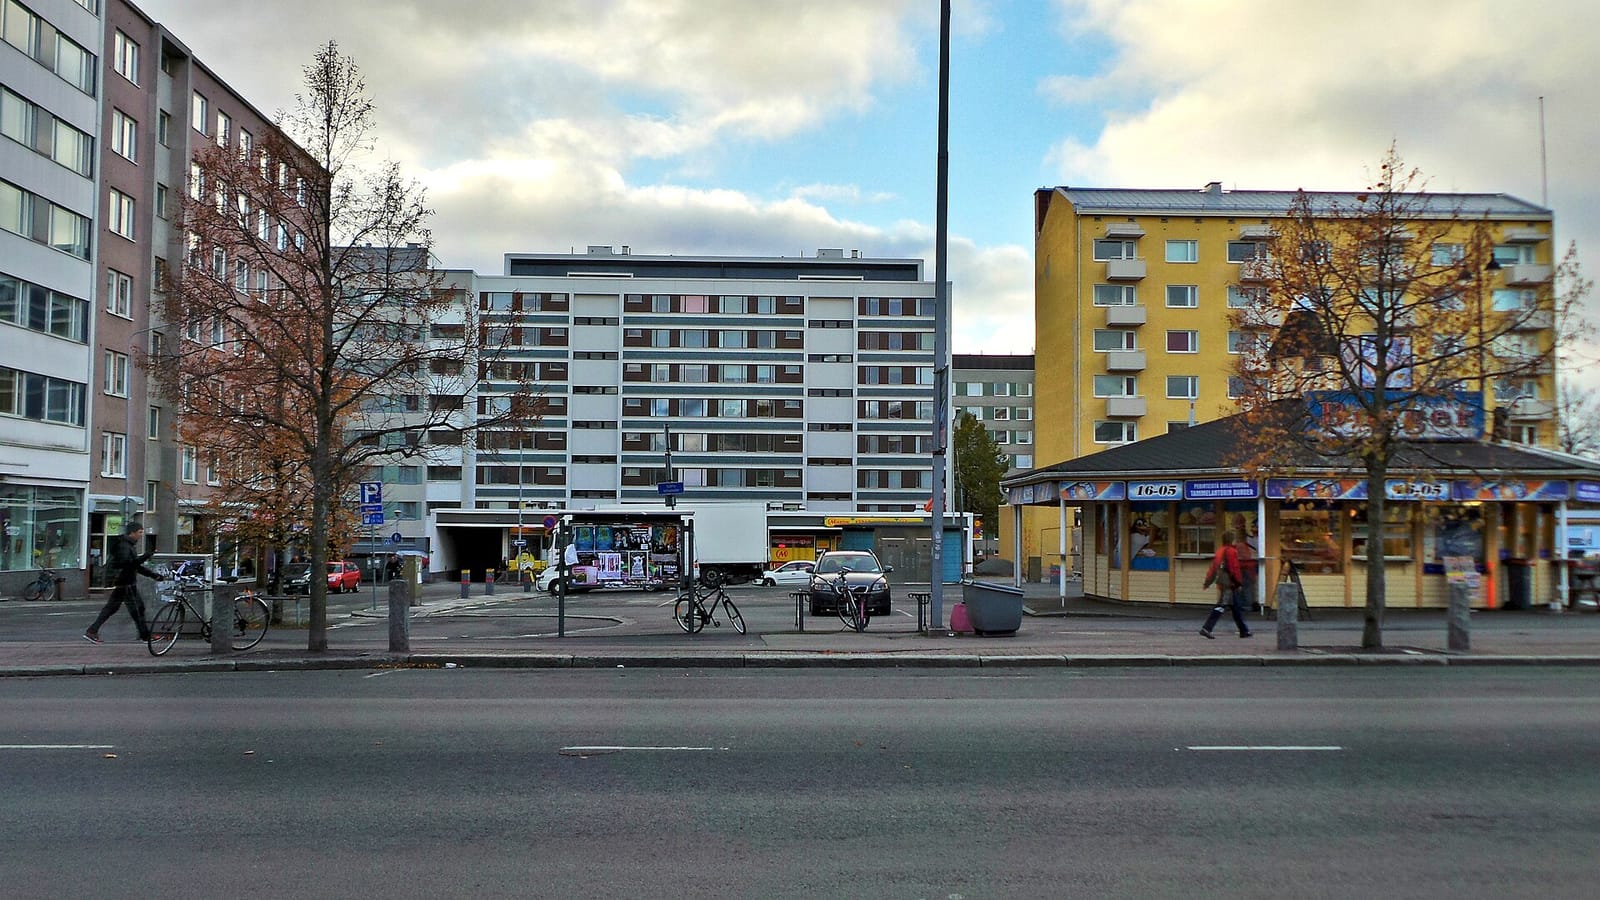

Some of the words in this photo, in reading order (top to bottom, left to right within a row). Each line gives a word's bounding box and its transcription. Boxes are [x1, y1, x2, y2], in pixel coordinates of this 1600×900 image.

[1320, 401, 1474, 435] Buger
[364, 484, 379, 503] P
[1137, 485, 1177, 496] 16-05
[1392, 483, 1442, 496] 6-05
